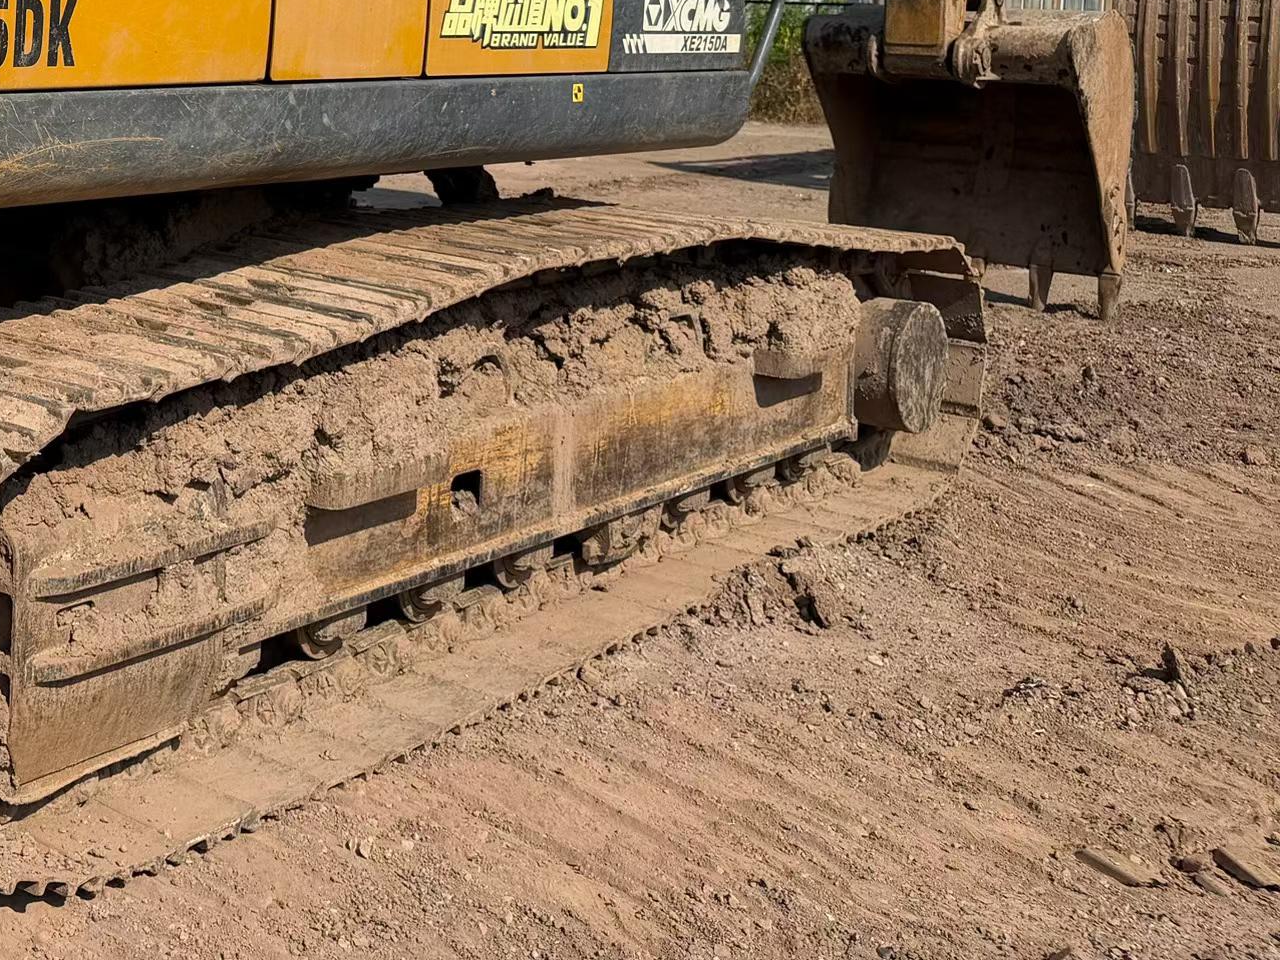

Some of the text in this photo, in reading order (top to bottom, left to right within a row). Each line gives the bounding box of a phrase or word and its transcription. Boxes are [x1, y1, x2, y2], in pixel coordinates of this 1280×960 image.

[490, 32, 586, 47] BRAND VALUE
[680, 35, 728, 52] XE215DA
